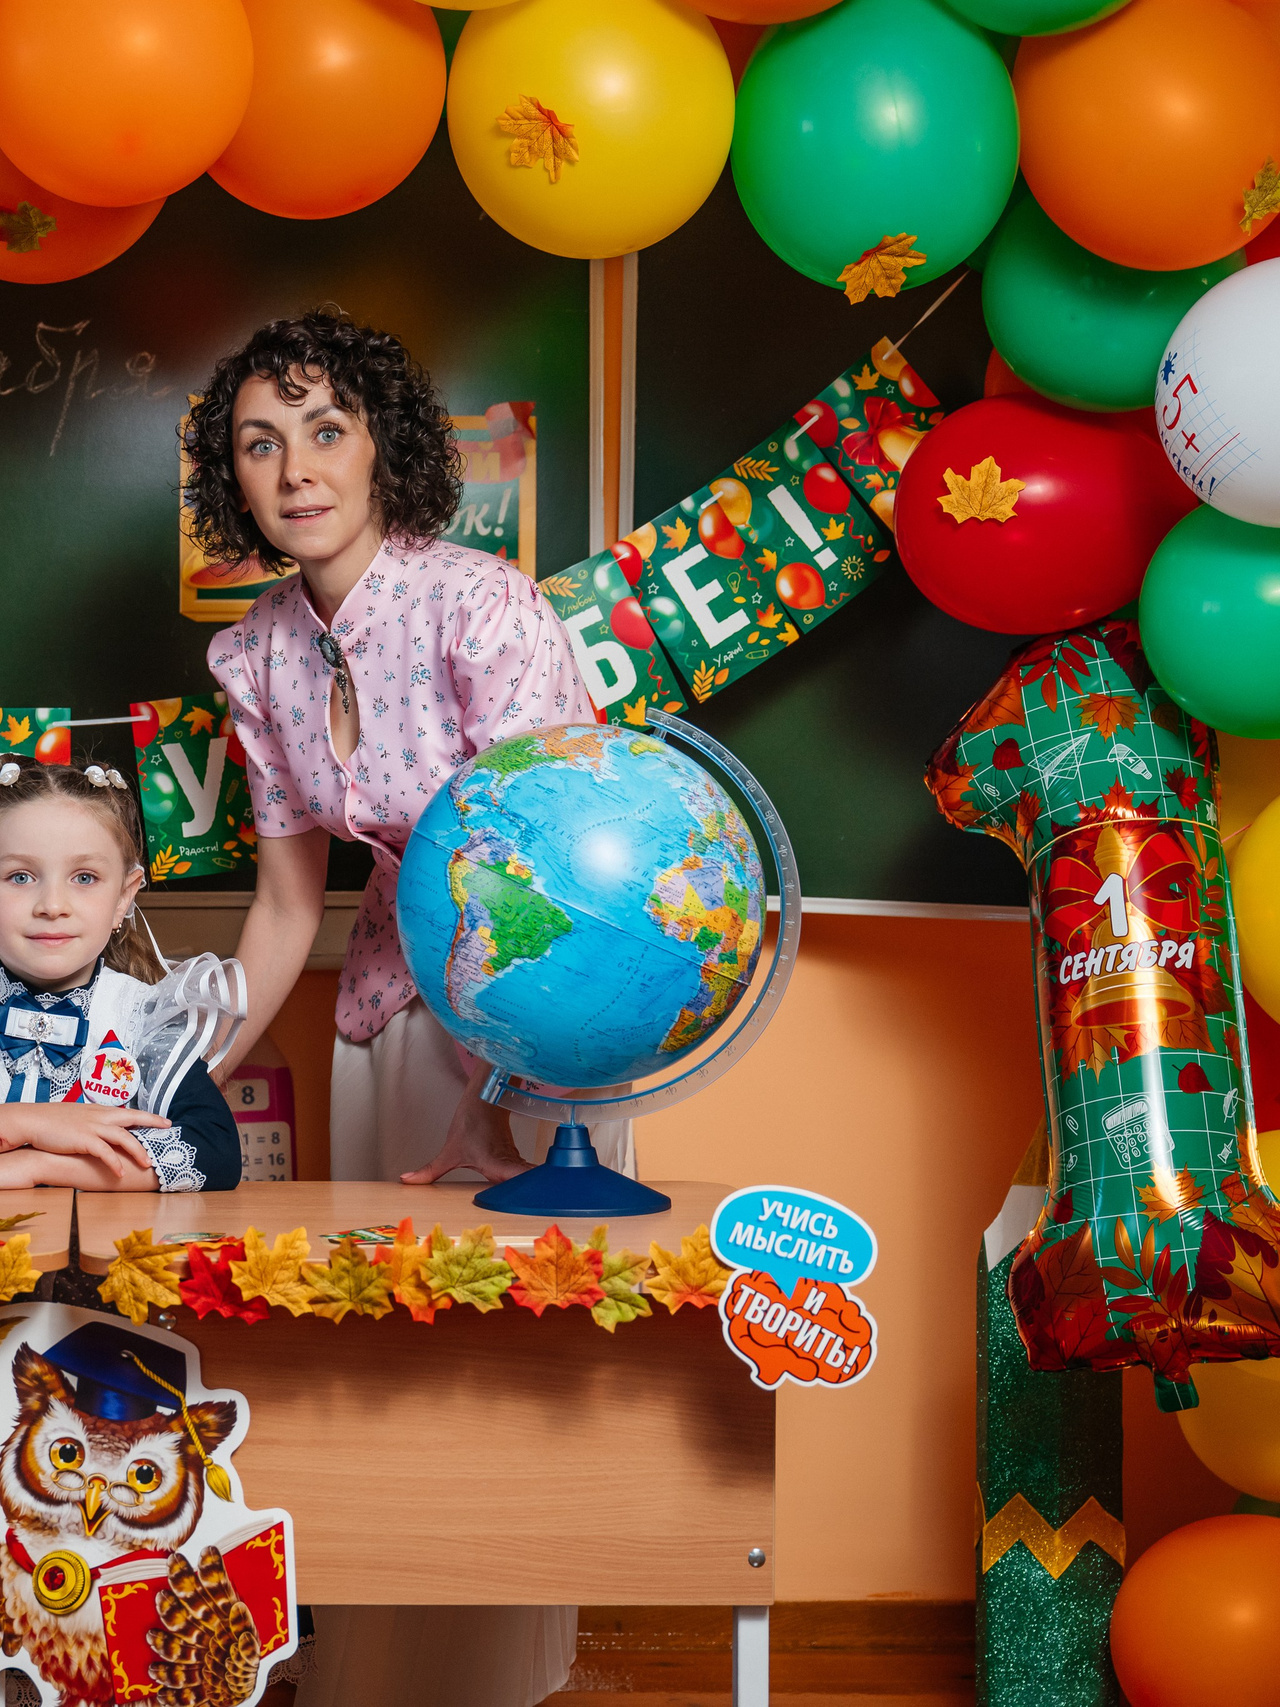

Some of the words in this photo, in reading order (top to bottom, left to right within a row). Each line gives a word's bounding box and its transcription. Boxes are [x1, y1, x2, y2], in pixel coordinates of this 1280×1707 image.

[179, 841, 219, 857] Радости!
[1093, 872, 1129, 938] 1
[1059, 940, 1195, 985] СЕНТЯБРЯ
[91, 1053, 107, 1081] 1
[84, 1079, 130, 1101] класс
[241, 1085, 255, 1105] 8
[271, 1132, 280, 1144] 8
[268, 1153, 285, 1166] 16
[758, 1197, 839, 1240] УЧИСЬ
[728, 1221, 854, 1275] МЫСЛИТЬ
[803, 1287, 827, 1316] И
[733, 1283, 861, 1375] ТВОРИТЬ!
